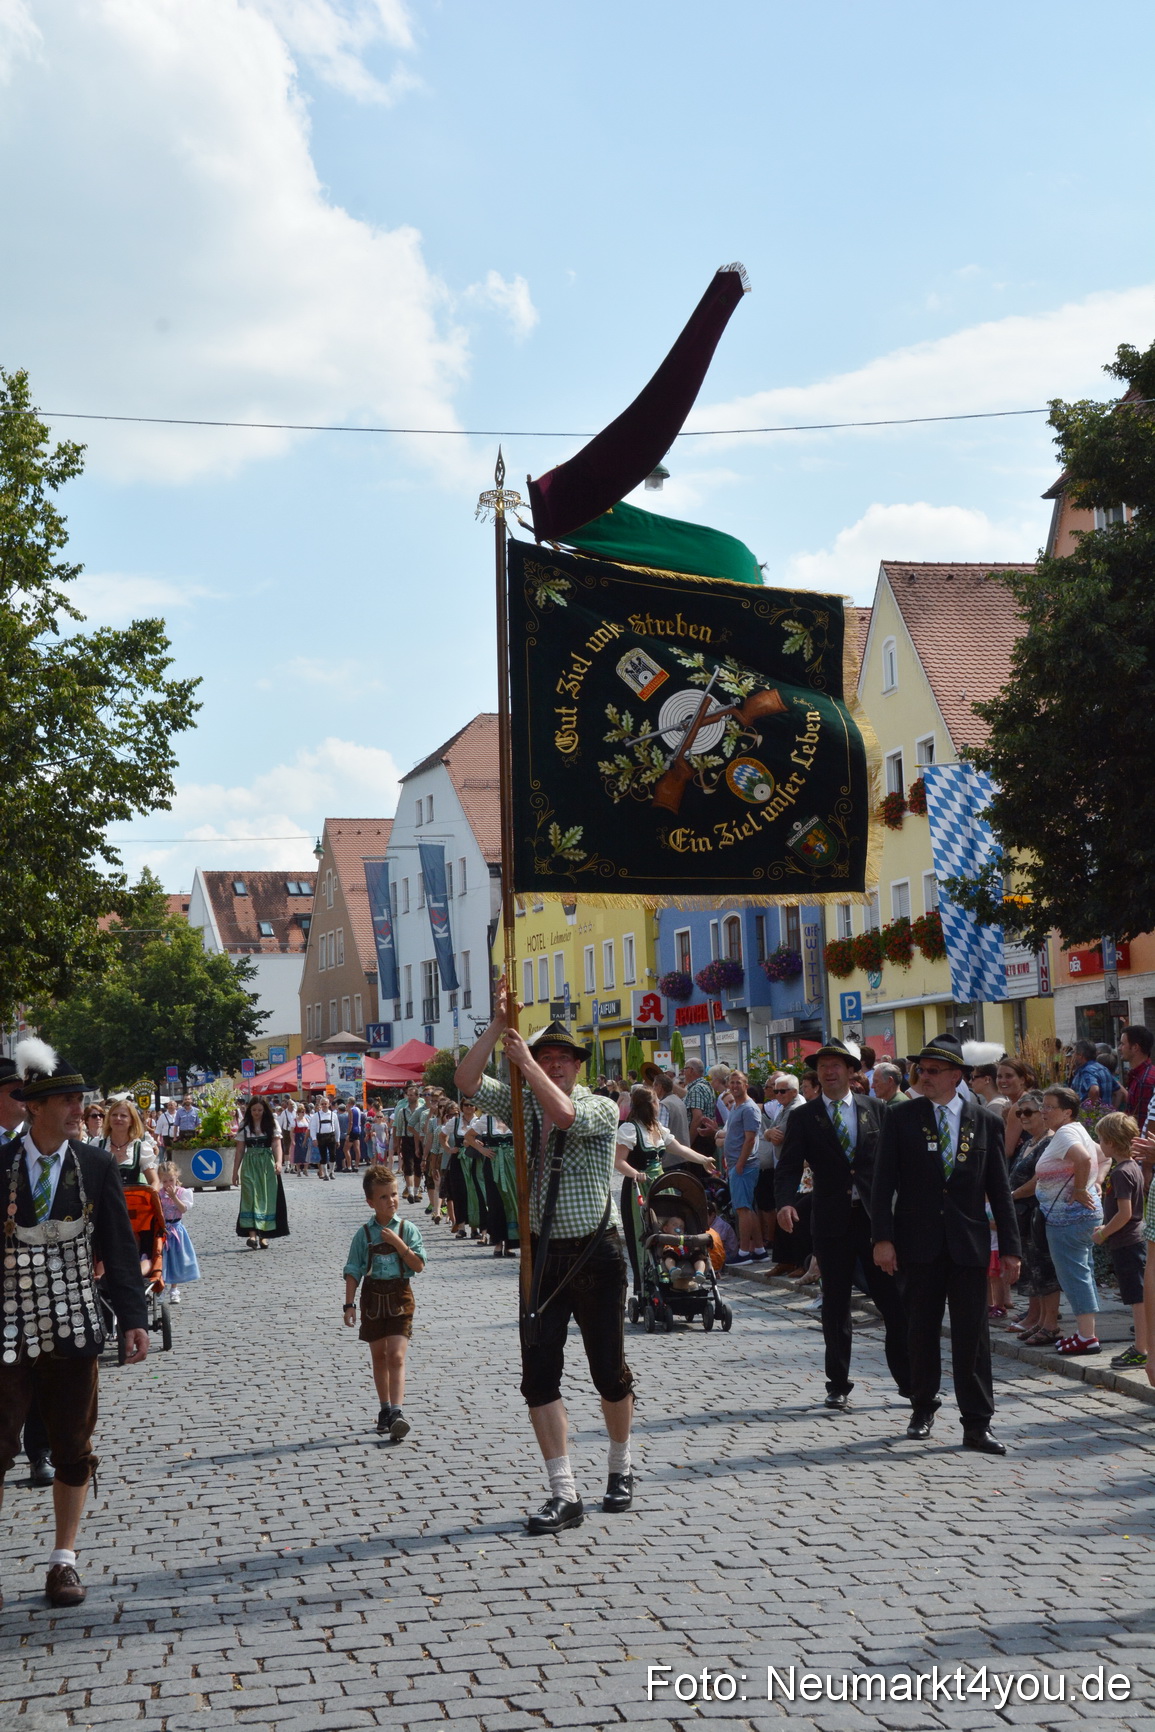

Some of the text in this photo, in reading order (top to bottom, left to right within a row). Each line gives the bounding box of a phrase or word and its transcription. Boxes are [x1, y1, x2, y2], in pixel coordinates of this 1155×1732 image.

[627, 612, 713, 644] Streben
[555, 651, 593, 700] Ziel
[554, 706, 579, 754] Gut
[668, 827, 713, 853] Ein
[713, 811, 763, 850] Ziel
[789, 710, 821, 771] Leben
[526, 932, 546, 953] HOTEL
[1040, 940, 1049, 993] KINO
[600, 1001, 617, 1016] AIFUN
[674, 1000, 722, 1027] APOTHEE
[844, 995, 857, 1019] P
